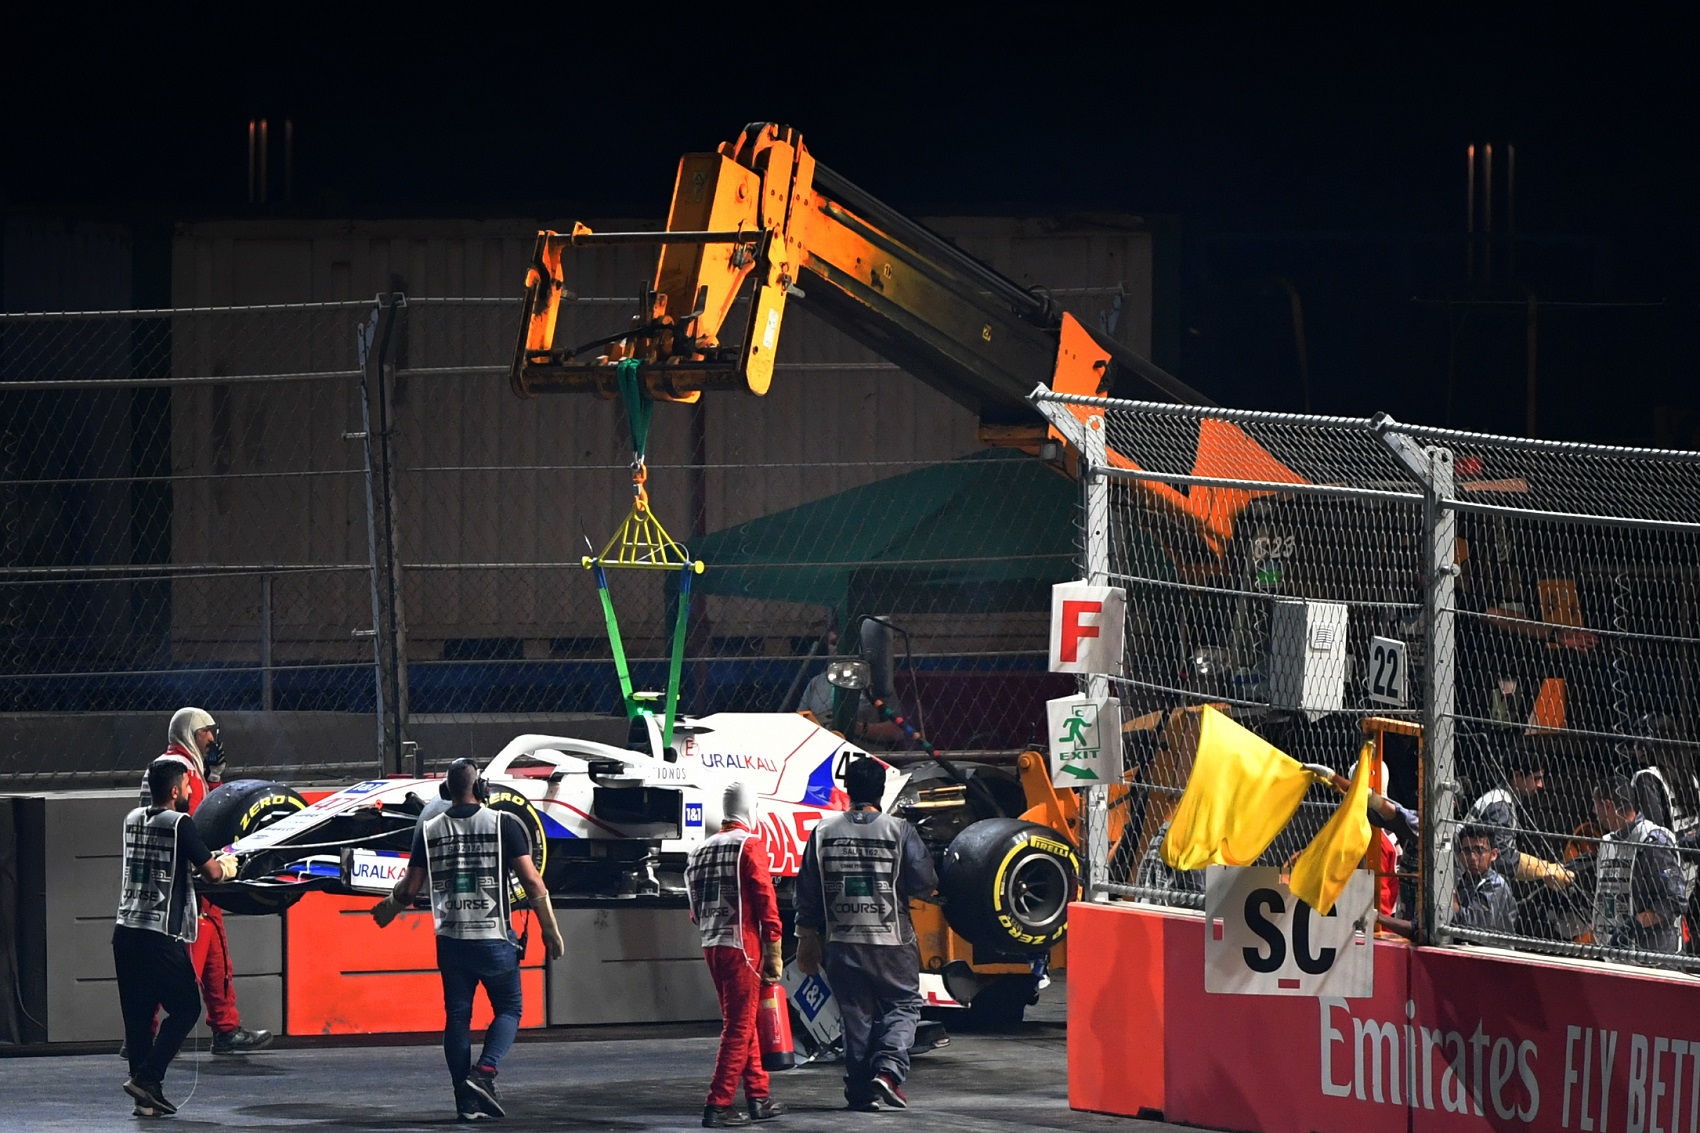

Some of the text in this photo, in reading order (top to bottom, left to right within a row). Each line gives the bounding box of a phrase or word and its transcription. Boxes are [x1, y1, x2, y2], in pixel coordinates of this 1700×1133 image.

[1059, 600, 1102, 663] F
[1373, 645, 1398, 699] 22
[701, 754, 777, 772] URALKALI
[1060, 750, 1100, 761] EXIT
[835, 751, 866, 788] 4
[240, 794, 286, 831] ZERO
[484, 792, 525, 807] ERO
[686, 807, 702, 821] 1&1
[1030, 835, 1070, 858] PIRELLI
[352, 863, 408, 880] URALKA
[443, 899, 489, 910] OURSE
[835, 903, 886, 913] COURSE
[998, 914, 1047, 945] ZERO
[1242, 888, 1338, 974] SC
[802, 975, 825, 1012] 1&1
[1319, 996, 1540, 1123] Emirates
[1562, 1025, 1618, 1133] FLY
